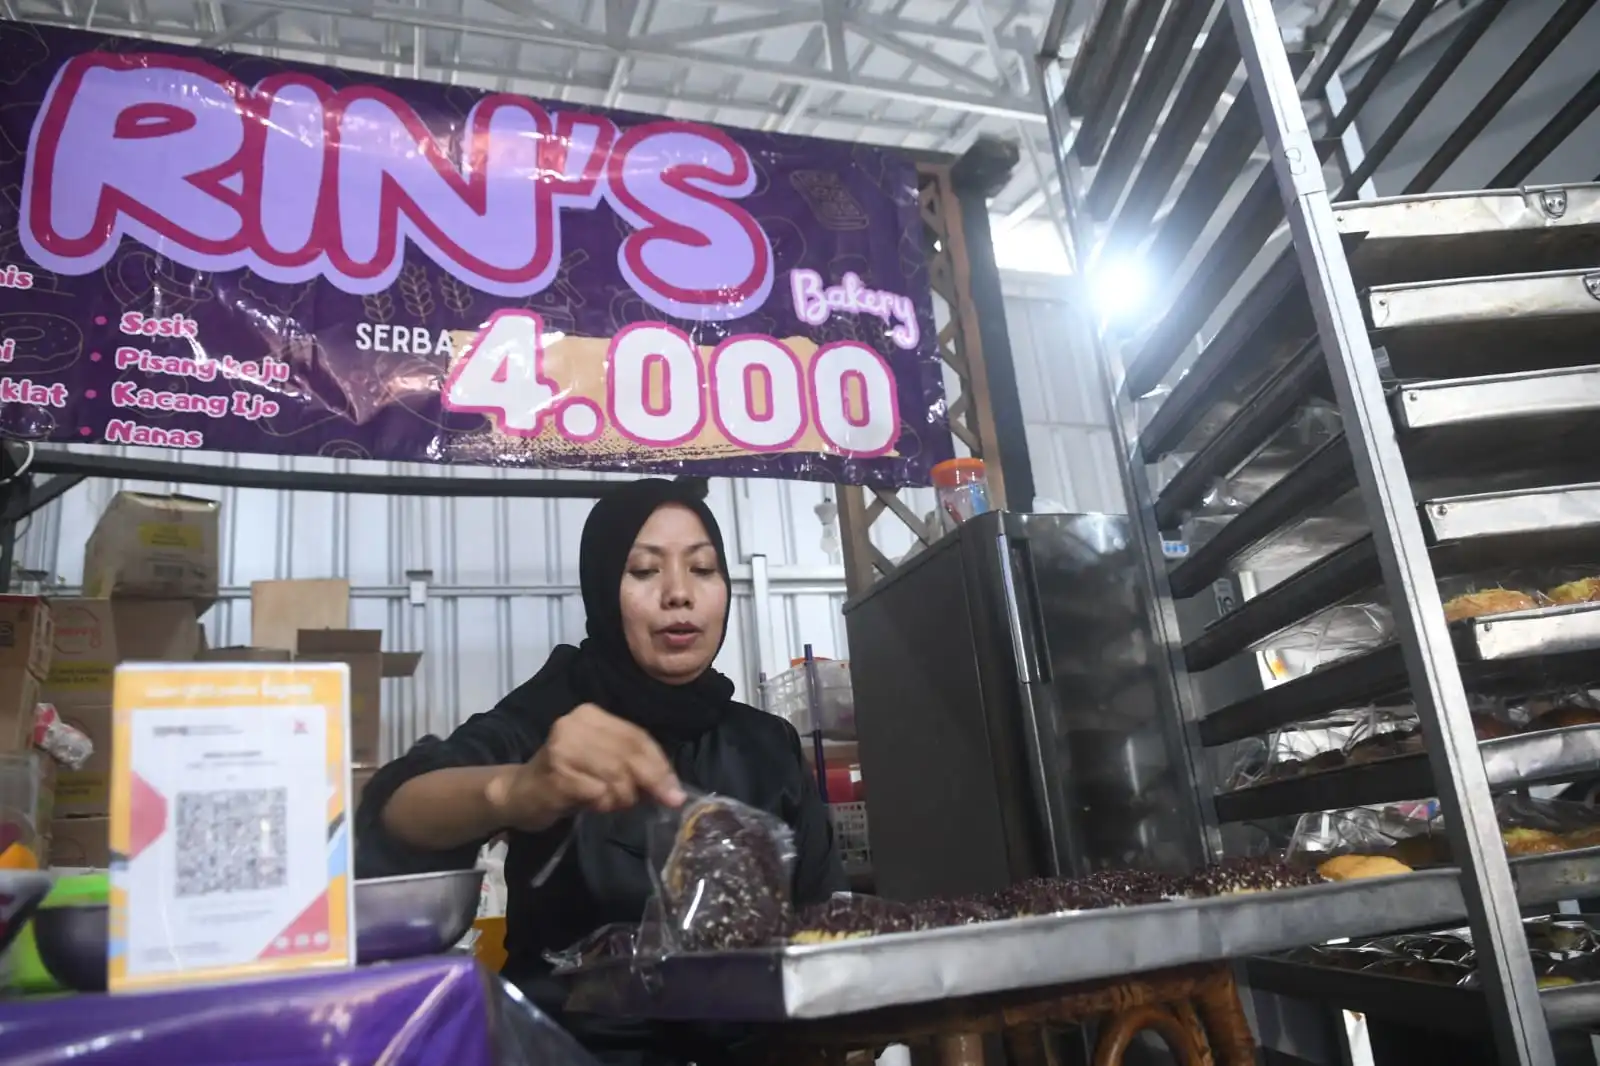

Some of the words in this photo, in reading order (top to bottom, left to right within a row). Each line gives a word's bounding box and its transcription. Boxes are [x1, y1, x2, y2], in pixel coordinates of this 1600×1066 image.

[19, 51, 775, 321] RIN'S
[120, 312, 198, 337] Sosis
[790, 268, 920, 350] Bakery
[116, 347, 218, 381] Pisang
[355, 322, 455, 358] SERBA
[442, 308, 900, 458] 4.000
[112, 381, 228, 418] Kacang
[233, 392, 280, 419] Ijo
[105, 419, 203, 447] Nanas
